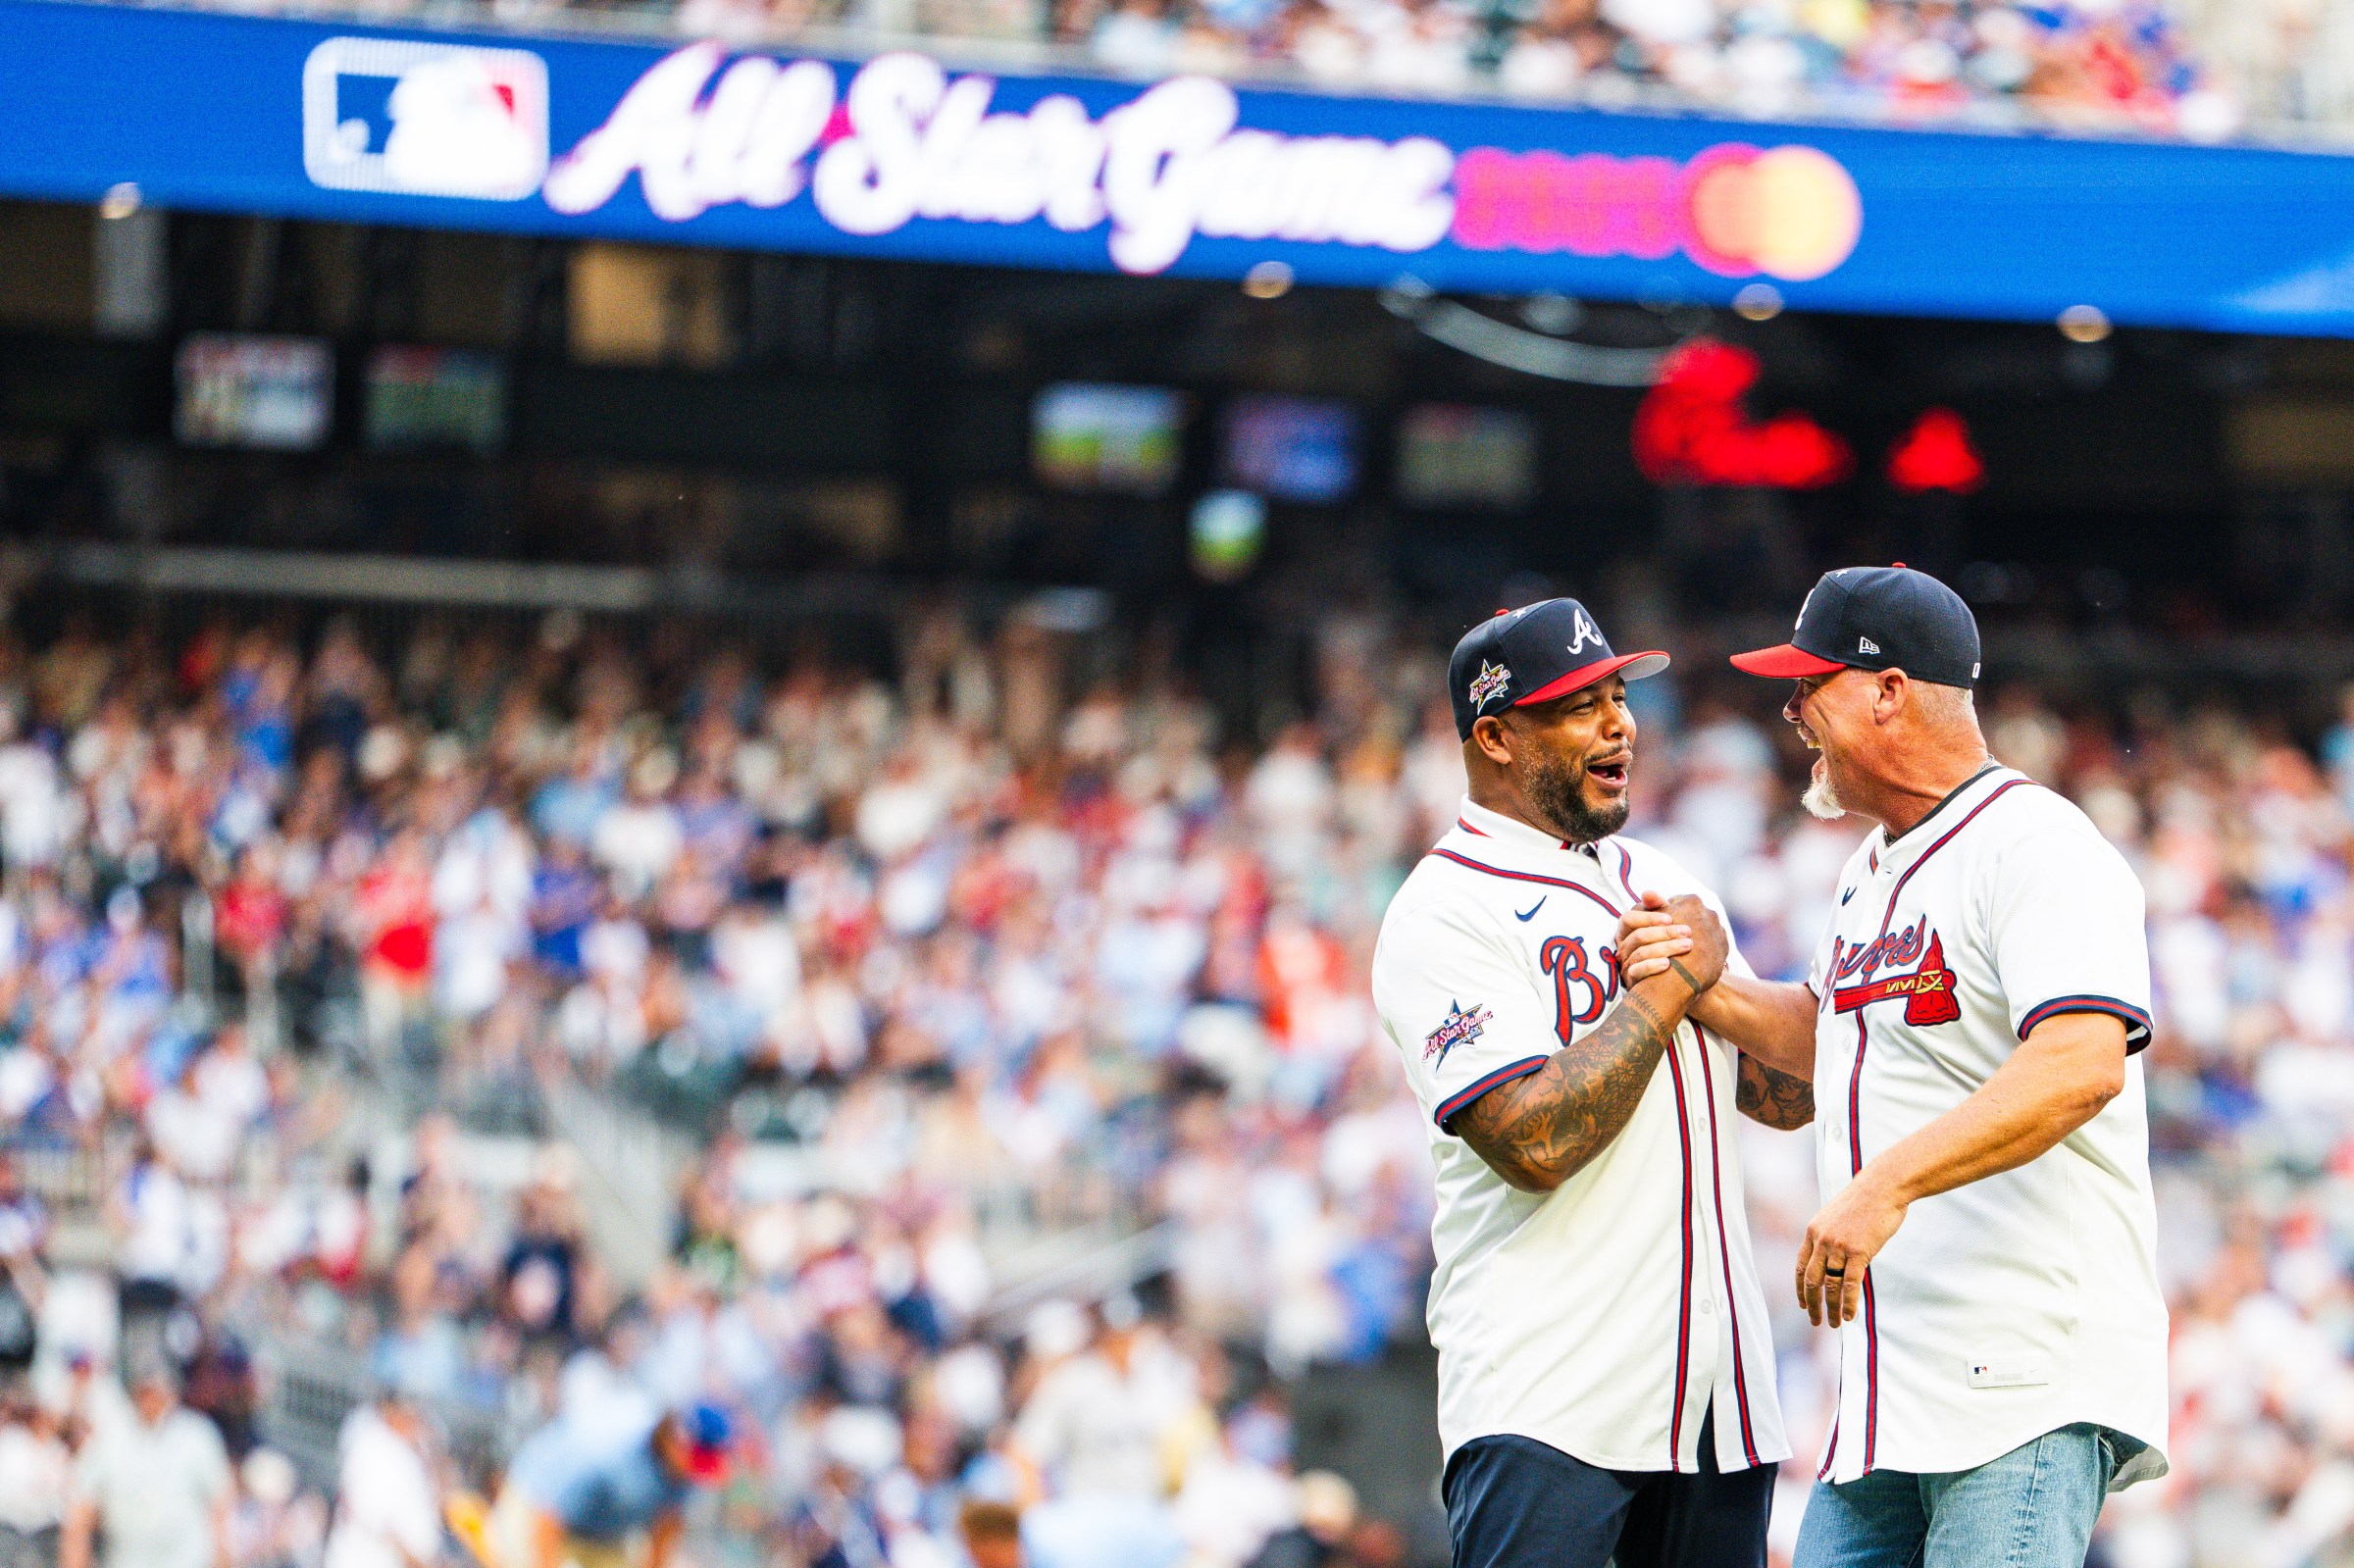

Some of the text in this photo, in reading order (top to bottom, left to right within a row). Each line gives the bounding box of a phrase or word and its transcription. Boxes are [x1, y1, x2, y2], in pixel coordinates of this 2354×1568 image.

[543, 39, 837, 222] All
[813, 51, 1110, 235] Star
[1104, 75, 1457, 277] Game
[1566, 608, 1604, 656] A
[1421, 1037, 1440, 1061] All
[1438, 1024, 1463, 1045] Star
[1459, 1010, 1494, 1034] Game
